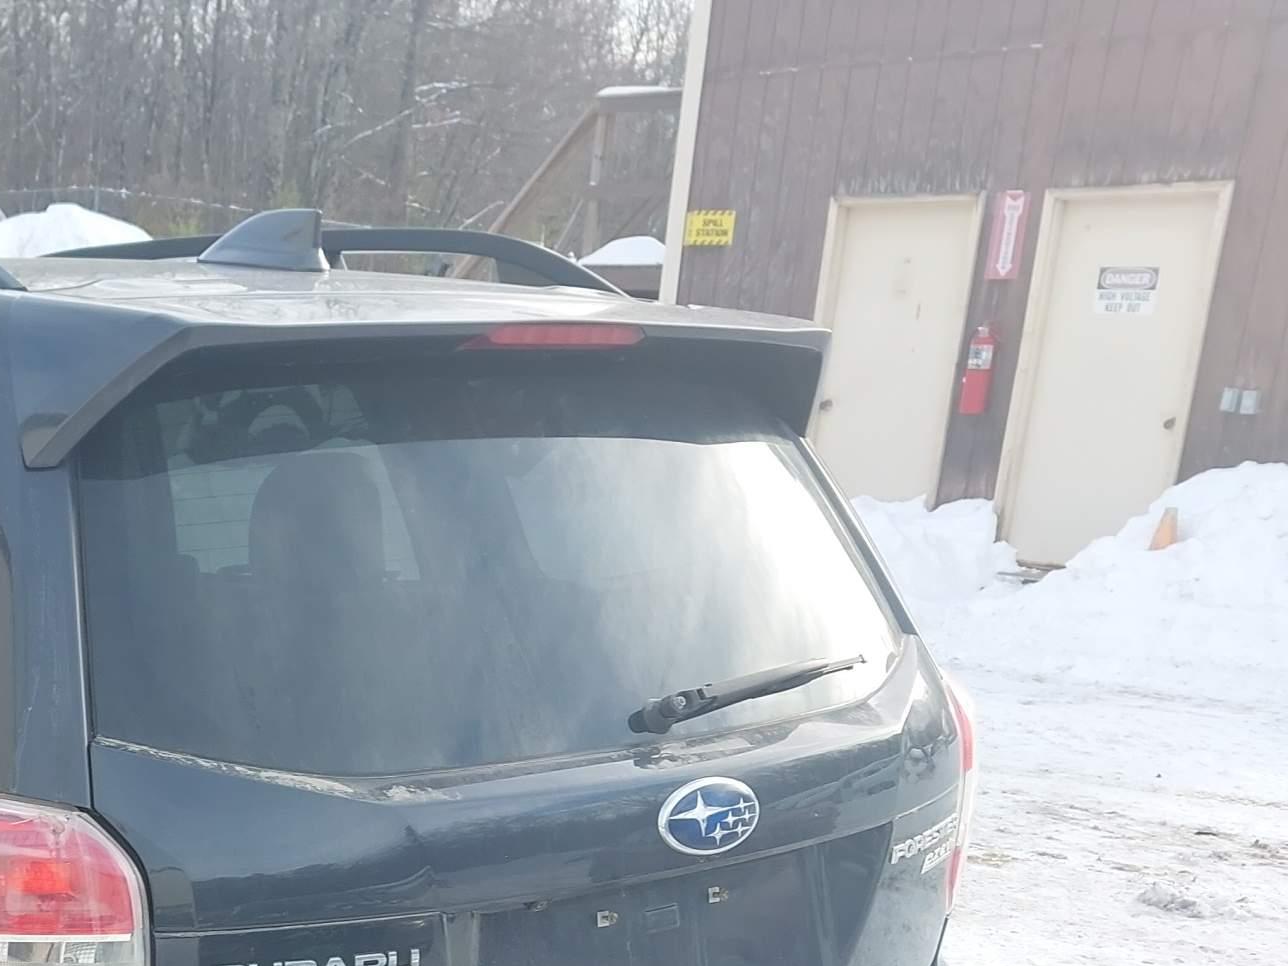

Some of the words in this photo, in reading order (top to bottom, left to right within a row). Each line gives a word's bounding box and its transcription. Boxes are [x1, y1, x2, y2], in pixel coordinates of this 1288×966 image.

[702, 219, 724, 227] SPILL
[695, 229, 728, 237] STATION
[1105, 272, 1152, 285] DANGER
[1098, 292, 1117, 301] HIGH
[1120, 292, 1151, 302] VOLTAGE
[1104, 303, 1123, 312] KEEP
[1126, 303, 1142, 312] OUT
